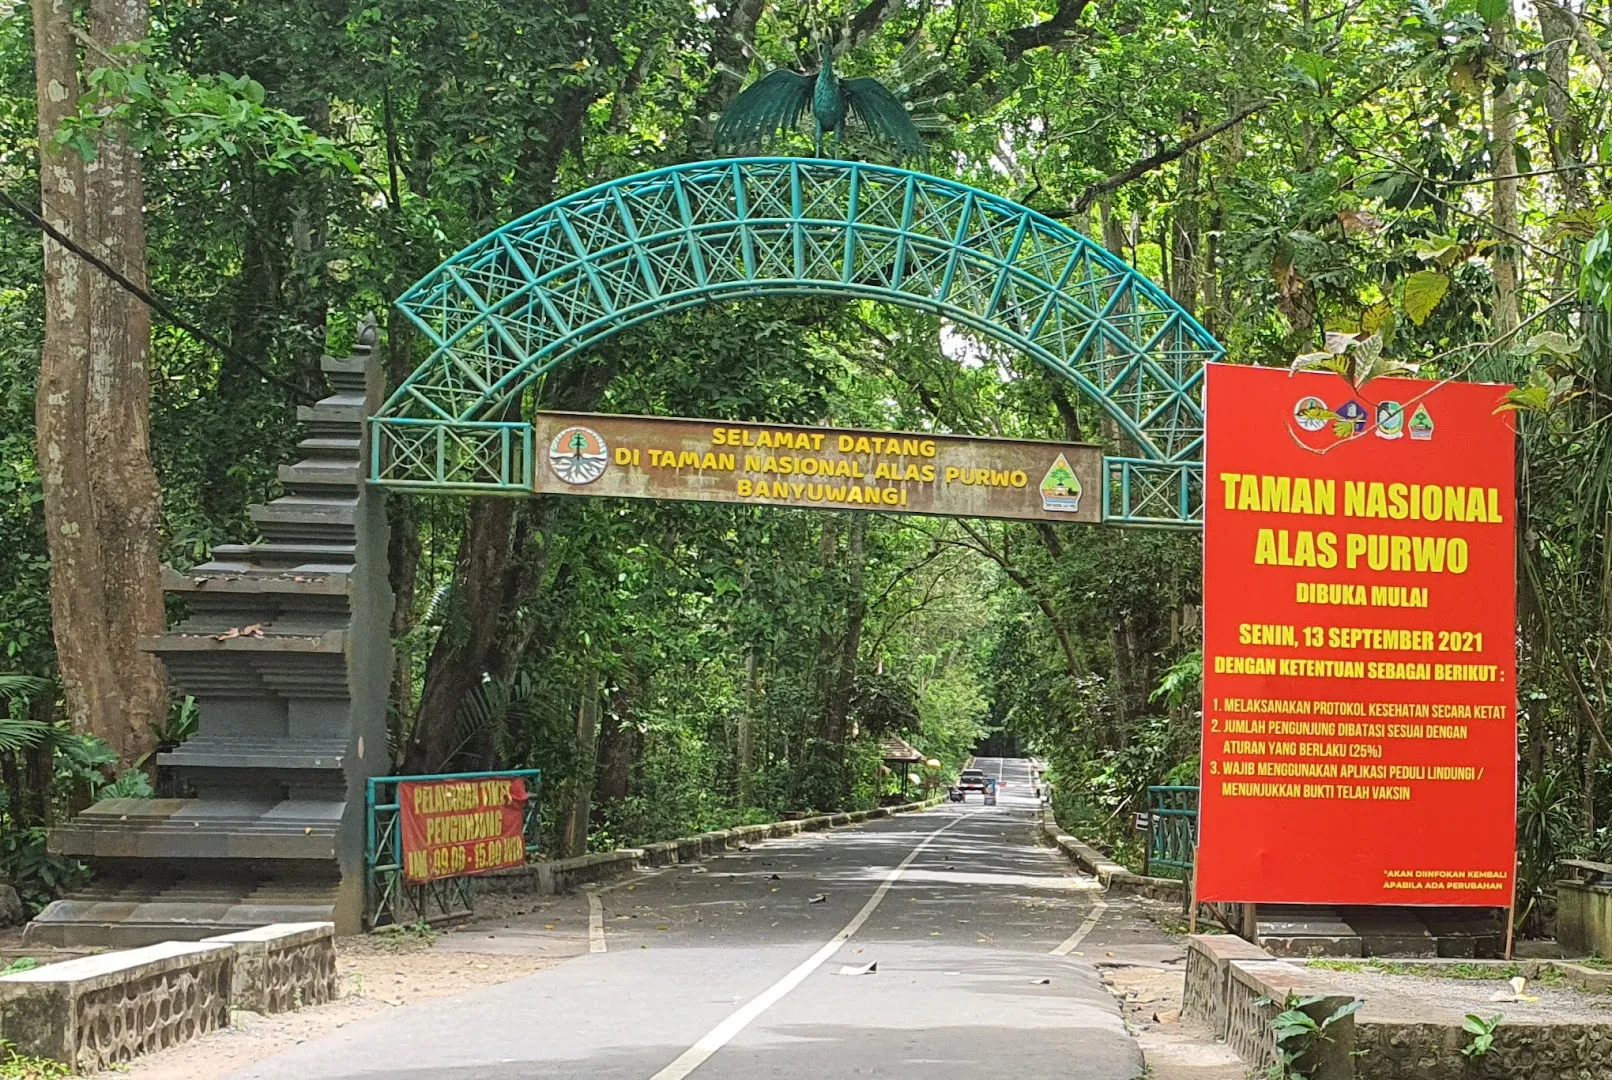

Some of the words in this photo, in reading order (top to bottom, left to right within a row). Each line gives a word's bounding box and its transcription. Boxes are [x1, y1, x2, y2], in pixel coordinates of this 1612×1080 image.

[712, 427, 825, 450] SELAMAT
[838, 435, 936, 458] DATANG
[615, 447, 640, 466] DI
[648, 449, 735, 471] TAMAN
[745, 455, 864, 479] NASIONAL
[875, 462, 935, 483] ALAS
[945, 466, 1028, 488] PURWO
[737, 479, 907, 506] BANYUWANGI
[1220, 472, 1335, 515] TAMAN
[1344, 481, 1502, 523] NASIONAL
[1254, 528, 1337, 568] ALAS
[1346, 533, 1468, 573] PURWO
[1296, 582, 1367, 605] DIBUKA
[1371, 585, 1428, 608] MULAI
[1239, 623, 1299, 648] SENIN,
[1303, 626, 1324, 647] 13
[1328, 627, 1434, 651] SEPTEMBER
[1438, 631, 1483, 652] 2021
[1214, 656, 1276, 675] DENGAN
[1279, 658, 1364, 678] KETENTUAN
[1367, 662, 1431, 680] SEBAGAI
[1434, 664, 1497, 682] BERIKUT
[1213, 698, 1222, 712] 1.
[1224, 698, 1311, 714] MELAKSANAKAN
[1313, 701, 1366, 716] PROTOKOL
[1369, 703, 1429, 718] KESEHATAN
[1431, 705, 1472, 718] SECARA
[1474, 705, 1506, 719] KETAT
[1211, 719, 1221, 733] 2.
[1223, 719, 1266, 734] JUMLAH
[1268, 721, 1335, 736] PENGUNJUNG
[1338, 723, 1385, 738] DIBATASI
[1387, 725, 1424, 739] SESUAI
[1426, 726, 1467, 739] DENGAN
[1223, 740, 1266, 755] ATURAN
[1268, 742, 1297, 755] YANG
[1299, 743, 1347, 757] BERLAKU
[1349, 744, 1383, 758] (25%)
[1210, 761, 1220, 775] 3.
[1223, 761, 1255, 775] WAJIB
[1258, 762, 1338, 777] MENGGUNAKAN
[1340, 765, 1387, 779] APLIKASI
[1389, 766, 1426, 780] PEDULI
[1427, 766, 1475, 780] LINDUNGI
[1477, 767, 1484, 780] /
[1222, 782, 1301, 798] MENUNJUKKAN
[1303, 784, 1334, 799] BUKTI
[1337, 786, 1370, 799] TELAH
[1372, 786, 1411, 800] VAKSIN
[1383, 881, 1422, 889] APABILA
[1416, 870, 1465, 878] DIINFOKAN
